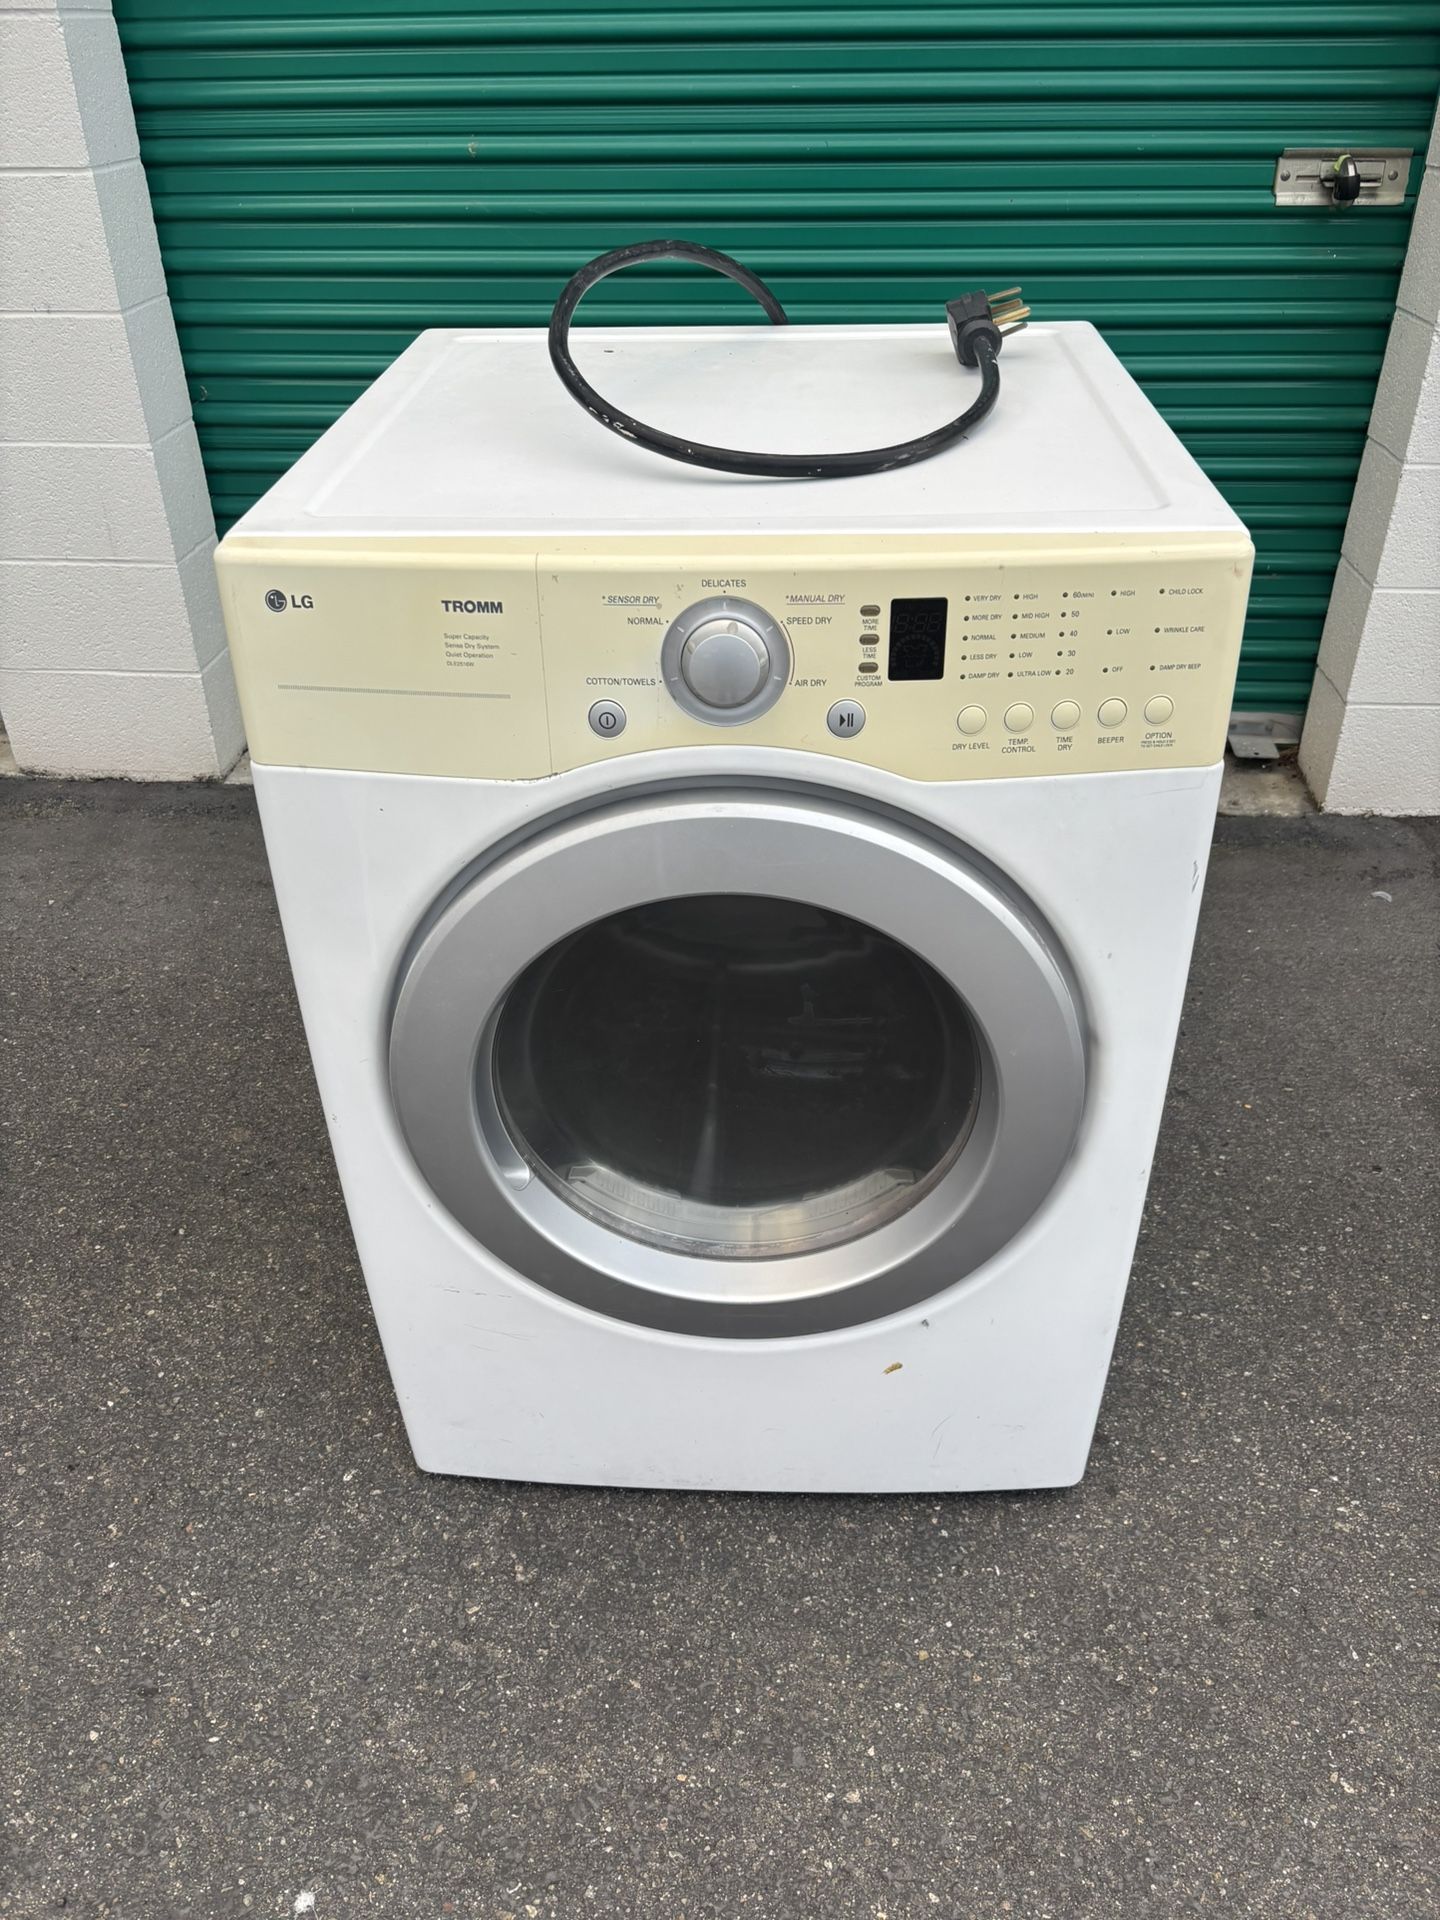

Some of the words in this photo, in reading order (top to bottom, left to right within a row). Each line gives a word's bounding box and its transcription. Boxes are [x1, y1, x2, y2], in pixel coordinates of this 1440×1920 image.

[702, 578, 746, 588] DELICATES
[290, 594, 314, 608] LG
[642, 596, 660, 604] DRY
[828, 594, 846, 602] DRY
[440, 600, 504, 614] TROMM
[628, 616, 664, 626] NORMAL
[786, 616, 814, 624] SPEED
[814, 616, 832, 624] DRY
[1066, 668, 1074, 676] 20
[586, 676, 656, 686] COTTON/TOWELS
[856, 674, 882, 682] CUSTOM
[1098, 736, 1124, 744] BEEPER
[1144, 732, 1172, 740] OPTION
[1008, 738, 1028, 746] TEMP.
[1002, 746, 1036, 754] CONTROL
[1058, 744, 1072, 752] DRY
